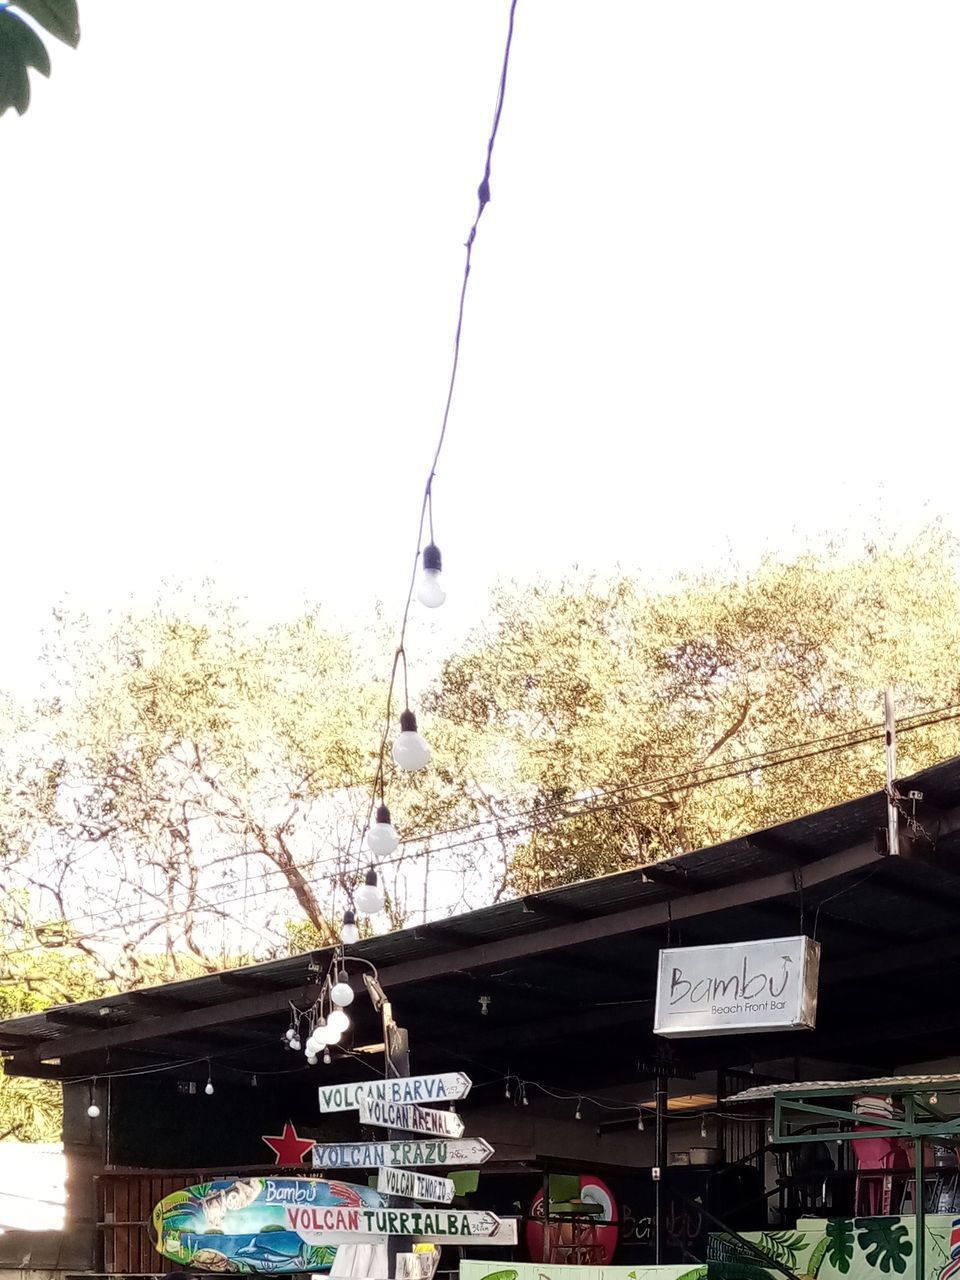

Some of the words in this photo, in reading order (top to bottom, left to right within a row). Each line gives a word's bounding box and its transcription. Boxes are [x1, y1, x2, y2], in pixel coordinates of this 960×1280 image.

[711, 1003, 743, 1015] Beach
[745, 1001, 768, 1012] Front
[770, 1001, 787, 1010] Bar
[321, 1084, 387, 1109] VOLCAN
[392, 1077, 447, 1102] BARVA
[367, 1101, 409, 1129] VOLCAN
[412, 1109, 452, 1135] ARENAL
[314, 1143, 385, 1166] VOLCAN
[386, 1172, 415, 1197] VOLCAN
[417, 1175, 447, 1201] TENORIO
[286, 1209, 359, 1232] VOLCAN
[363, 1211, 472, 1236] TURRIALBA
